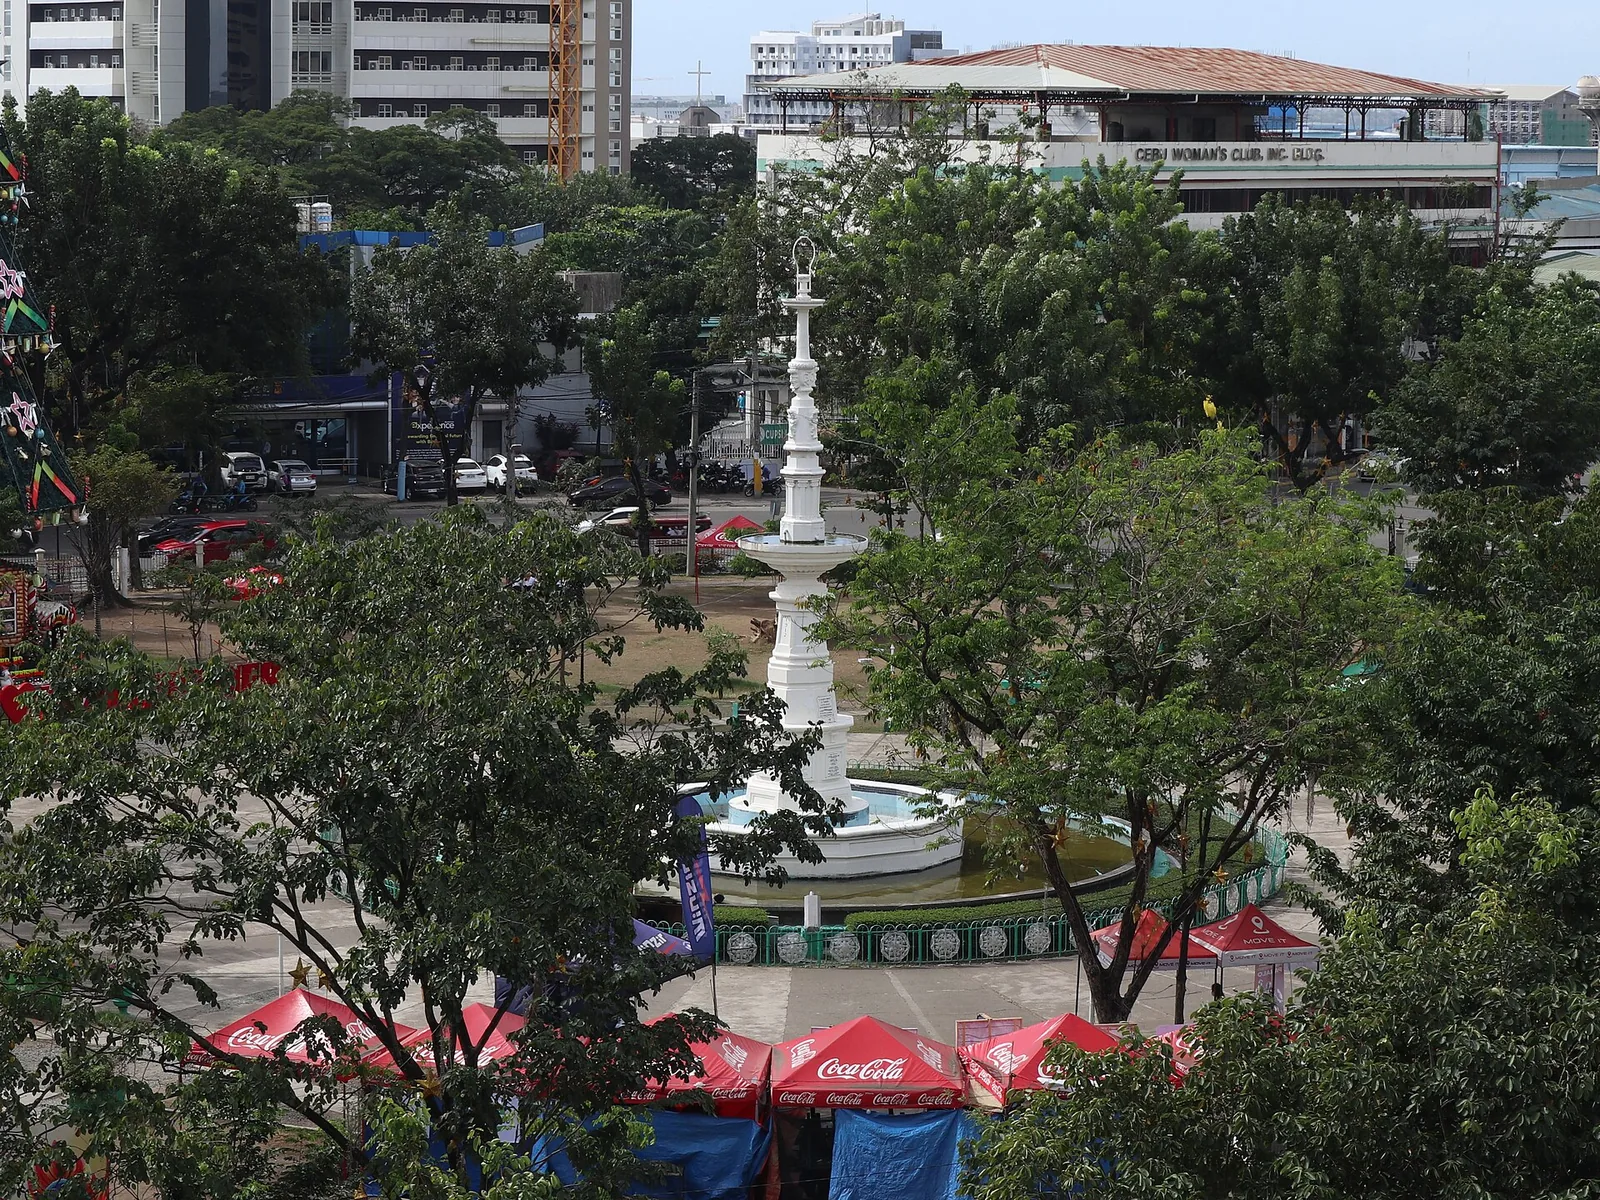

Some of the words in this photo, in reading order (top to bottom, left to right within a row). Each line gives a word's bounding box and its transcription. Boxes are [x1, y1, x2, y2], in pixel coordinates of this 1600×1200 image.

[1135, 147, 1167, 162] CEBU
[1171, 146, 1228, 162] WOMAN'S
[1243, 937, 1275, 945] MOVE
[817, 1058, 908, 1080] Coca-Cola
[712, 1087, 750, 1100] Coca-Cola
[779, 1091, 817, 1104] Coca-Cola
[826, 1092, 864, 1105] Coca-Cola
[872, 1092, 911, 1106] Coca-Cola
[917, 1092, 955, 1105] Coca-Cola
